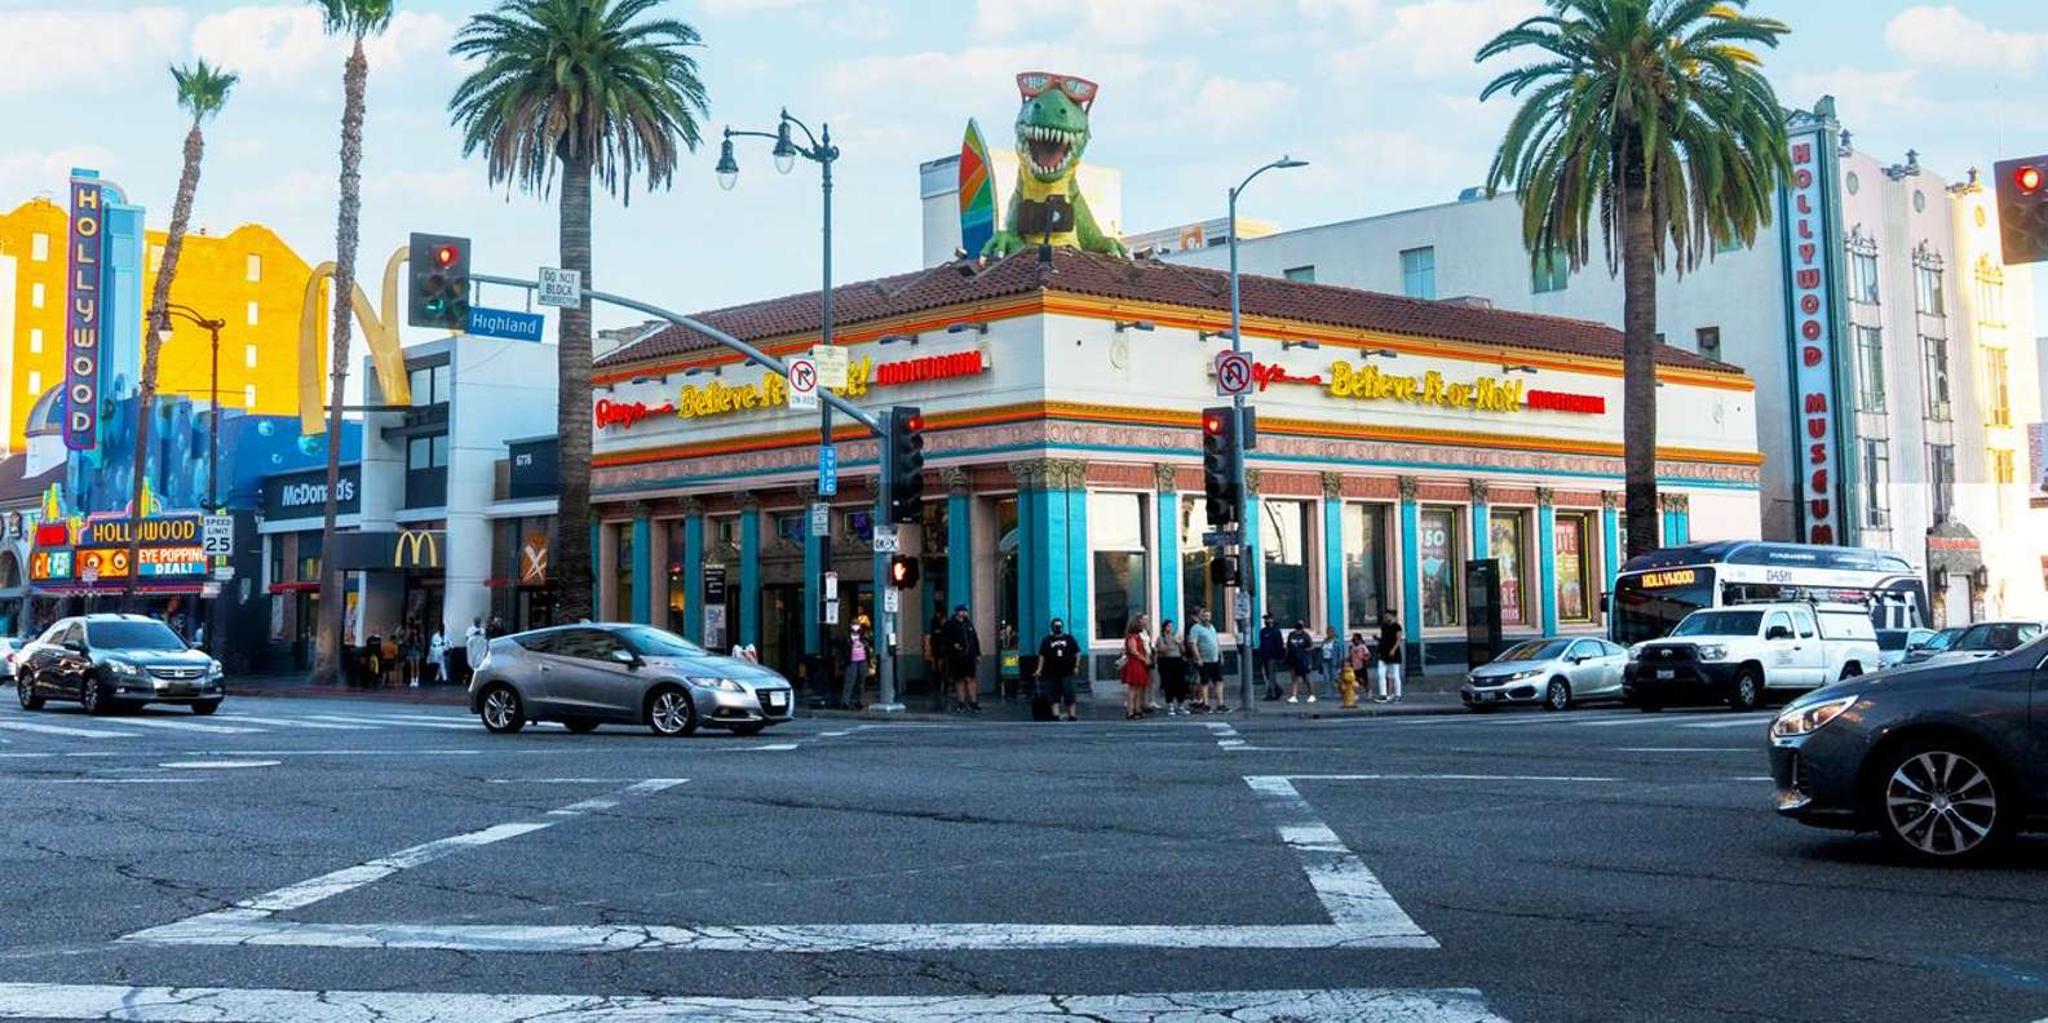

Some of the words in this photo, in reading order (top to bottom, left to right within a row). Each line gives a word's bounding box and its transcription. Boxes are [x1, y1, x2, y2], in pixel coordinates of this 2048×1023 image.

[1792, 143, 1821, 367] HOLLYWOOD
[546, 283, 573, 297] BLOCK
[71, 188, 99, 432] HOLLYWOOD
[473, 313, 536, 334] Highland
[1331, 361, 1418, 402] Believe
[1424, 371, 1445, 405] It
[1447, 383, 1473, 409] or
[1475, 376, 1524, 413] Not!
[678, 381, 756, 418] Believe
[1805, 393, 1833, 544] MUSEUM
[282, 479, 354, 506] McDond's
[206, 537, 231, 552] 25
[139, 548, 158, 563] EYE
[160, 548, 208, 563] POPPING
[155, 563, 193, 575] DEAL!
[1642, 570, 1695, 588] HOLLYWOOD
[1766, 569, 1792, 582] DASH
